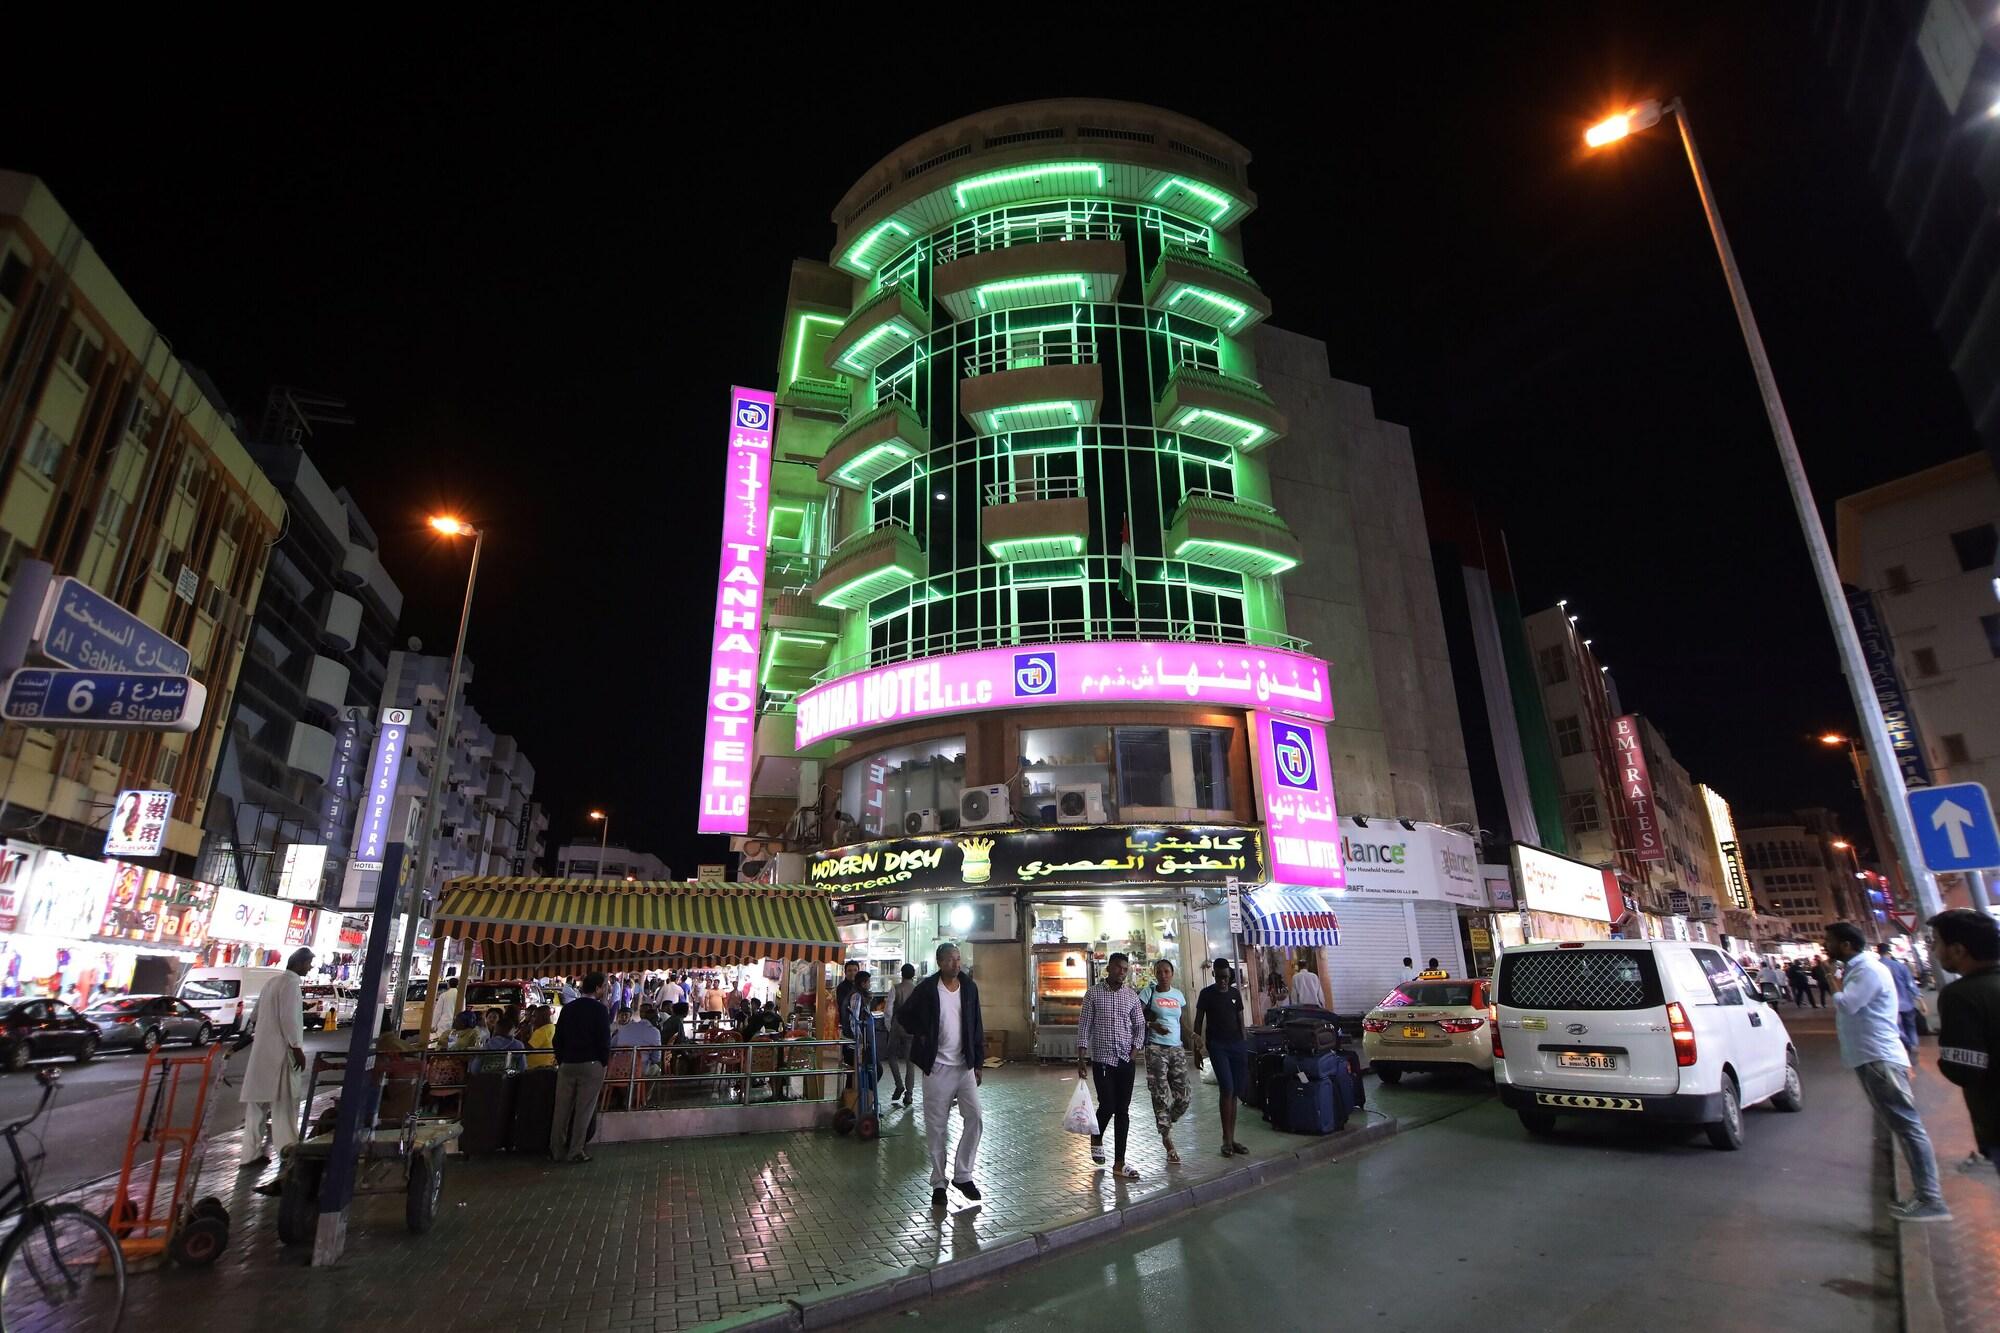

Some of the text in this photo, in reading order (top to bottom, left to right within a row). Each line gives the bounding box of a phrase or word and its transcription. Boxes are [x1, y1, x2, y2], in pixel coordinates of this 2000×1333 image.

[733, 433, 768, 449] فندق
[717, 543, 759, 653] TANHA
[64, 592, 181, 674] شارع السبخة
[52, 627, 134, 673] Al Sabkh
[131, 681, 185, 702] شارع
[1156, 656, 1251, 696] تنها
[1257, 660, 1322, 702] فندق
[11, 702, 39, 716] 118
[67, 679, 96, 713] 6
[109, 701, 180, 720] a Street
[797, 681, 858, 746] TANHA
[863, 662, 944, 722] HOTEL
[713, 668, 752, 787] HOTEL
[365, 730, 399, 857] OASIS DEIRA
[1616, 720, 1654, 848] EMIRATES
[1297, 794, 1333, 824] فندق
[1125, 835, 1246, 853] كافيتريا
[1341, 836, 1406, 866] lance
[811, 848, 942, 881] MODERN DISH
[1017, 855, 1246, 880] الطبق العصري
[815, 870, 913, 893] CAFETERIA
[1560, 1056, 1566, 1066] L
[1584, 1056, 1616, 1068] 36189
